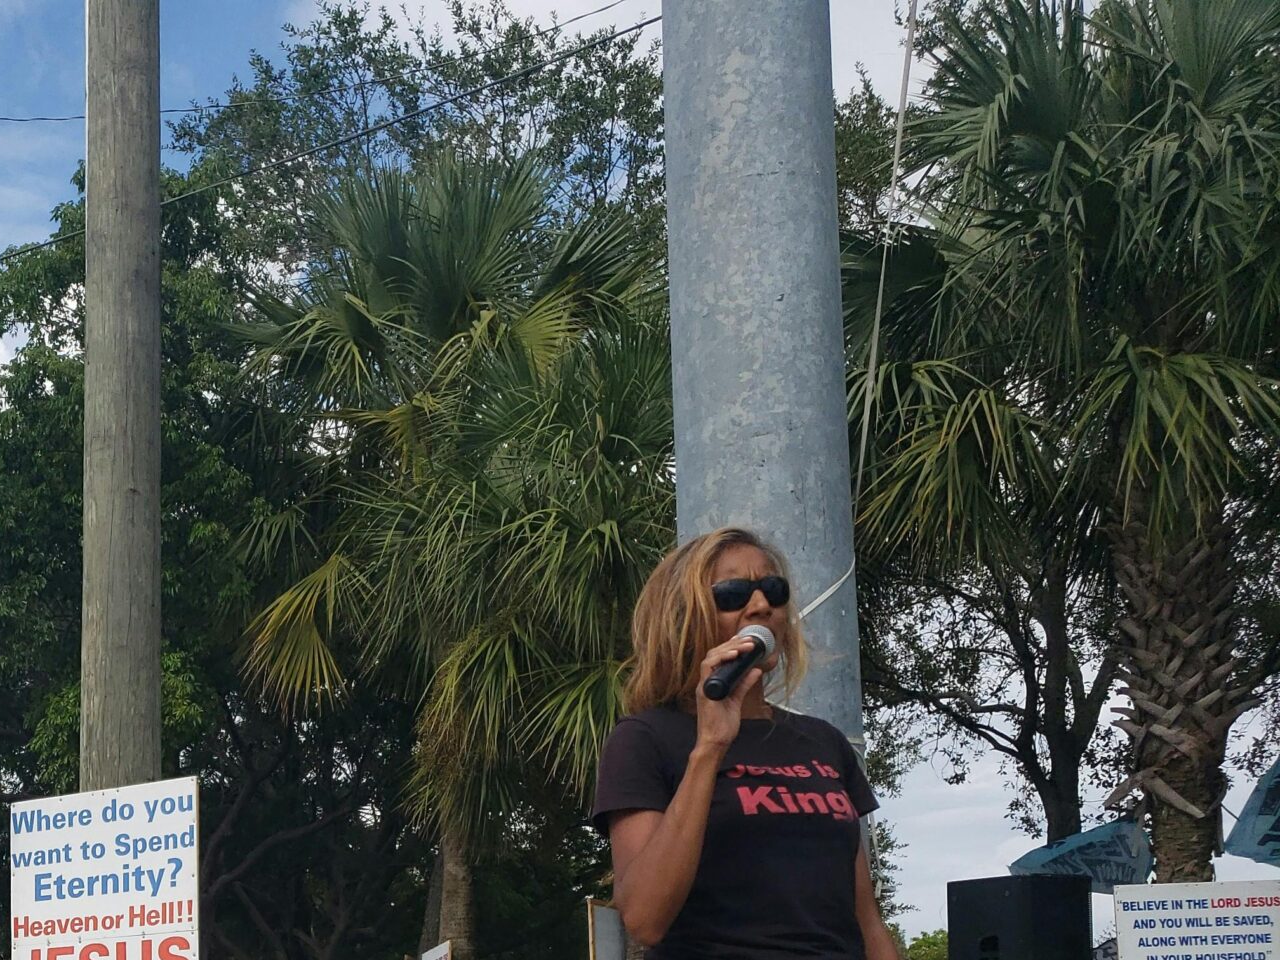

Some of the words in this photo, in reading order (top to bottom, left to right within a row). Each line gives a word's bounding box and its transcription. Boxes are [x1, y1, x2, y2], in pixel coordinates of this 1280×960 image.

[811, 760, 840, 779] is
[12, 808, 92, 834] Where
[101, 798, 134, 823] do
[144, 794, 193, 823] you
[12, 843, 72, 868] want
[80, 841, 105, 861] to
[114, 825, 195, 859] Spend
[34, 858, 183, 902] Eternity?
[1171, 899, 1183, 910] IN
[1185, 898, 1209, 910] THE
[1211, 897, 1241, 909] LORD
[1244, 896, 1280, 908] JESUS
[13, 914, 98, 938] Heaven
[101, 913, 124, 932] or
[128, 900, 193, 928] Hell!!
[1133, 919, 1156, 929] AND
[1159, 918, 1182, 929] YOU
[1185, 917, 1212, 928] WILL
[1215, 916, 1230, 927] BE
[1233, 915, 1274, 927] SAVED,
[1138, 937, 1176, 948] ALONG
[1178, 935, 1208, 947] WITH
[1211, 933, 1272, 945] EVERYONE
